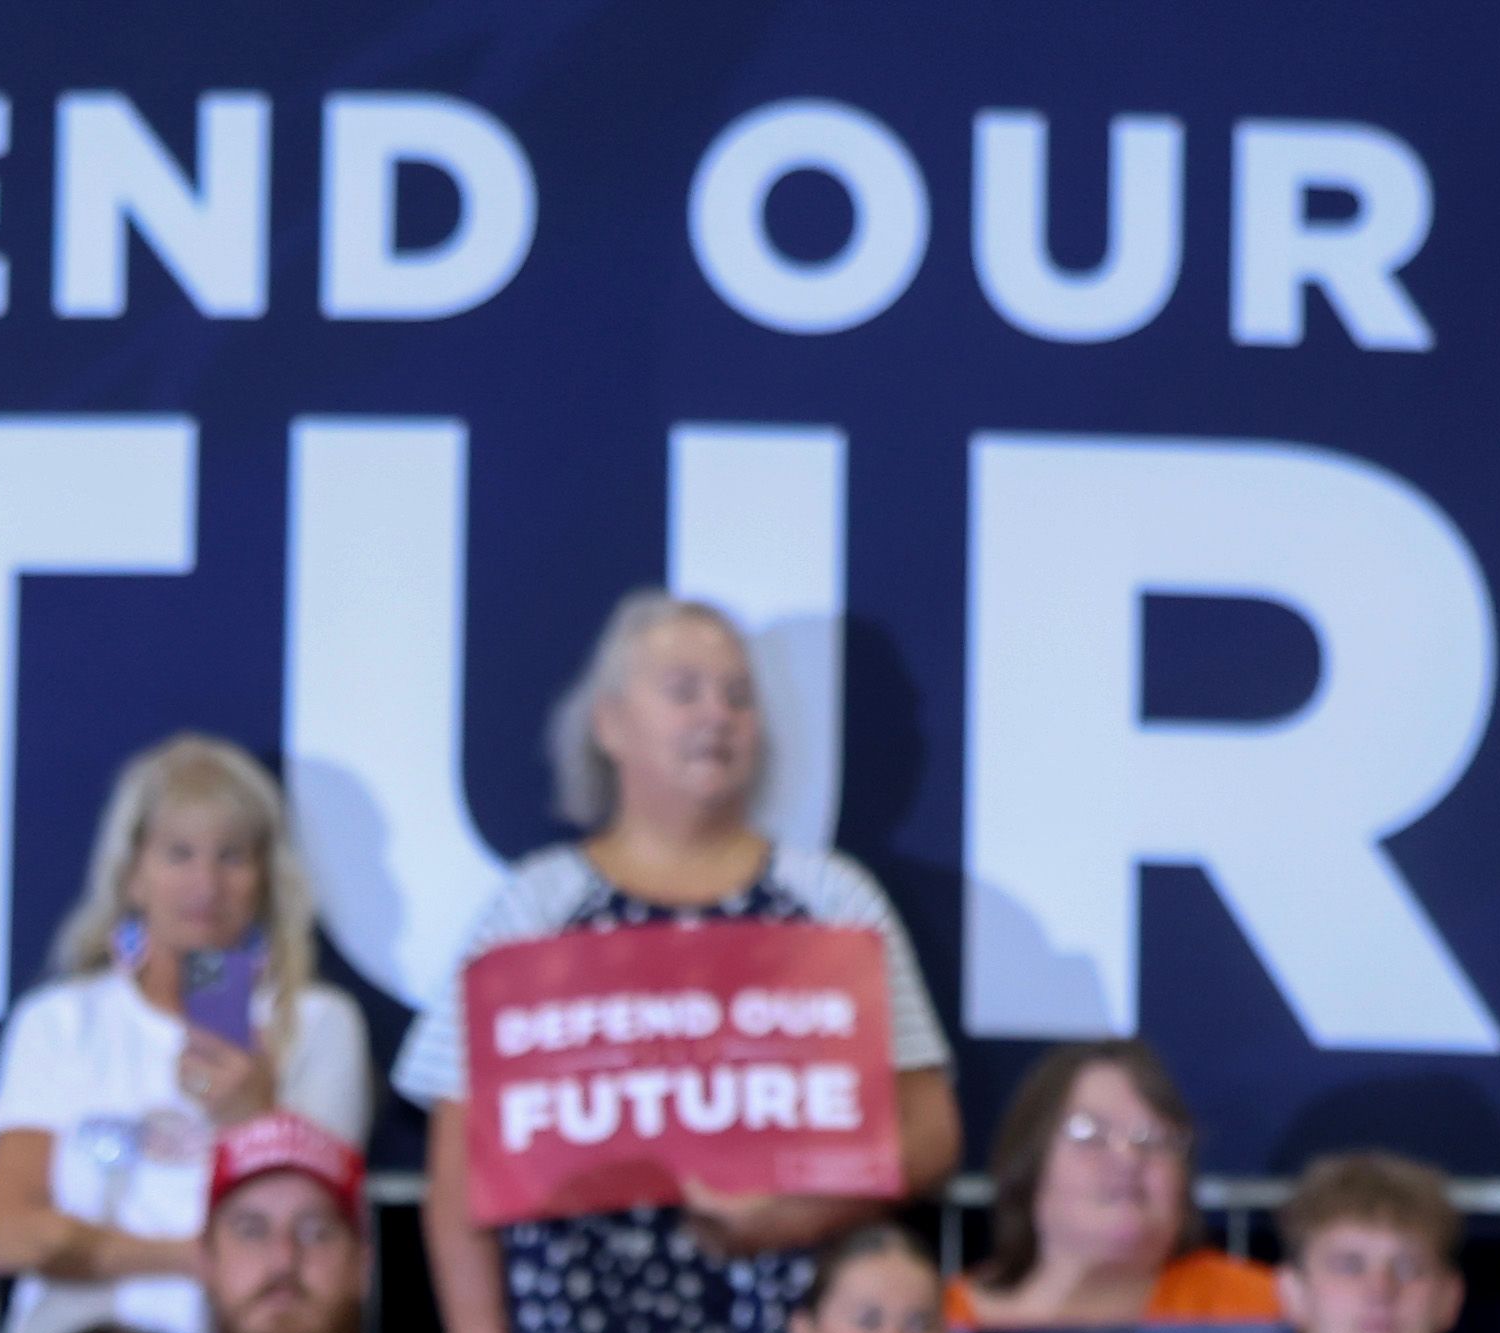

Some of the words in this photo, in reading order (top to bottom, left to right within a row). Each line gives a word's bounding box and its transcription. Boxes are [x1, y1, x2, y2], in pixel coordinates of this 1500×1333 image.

[690, 104, 1431, 351] OUR
[495, 991, 722, 1057] DEFEND
[731, 987, 857, 1038] OUR
[501, 1062, 862, 1154] FUTURE
